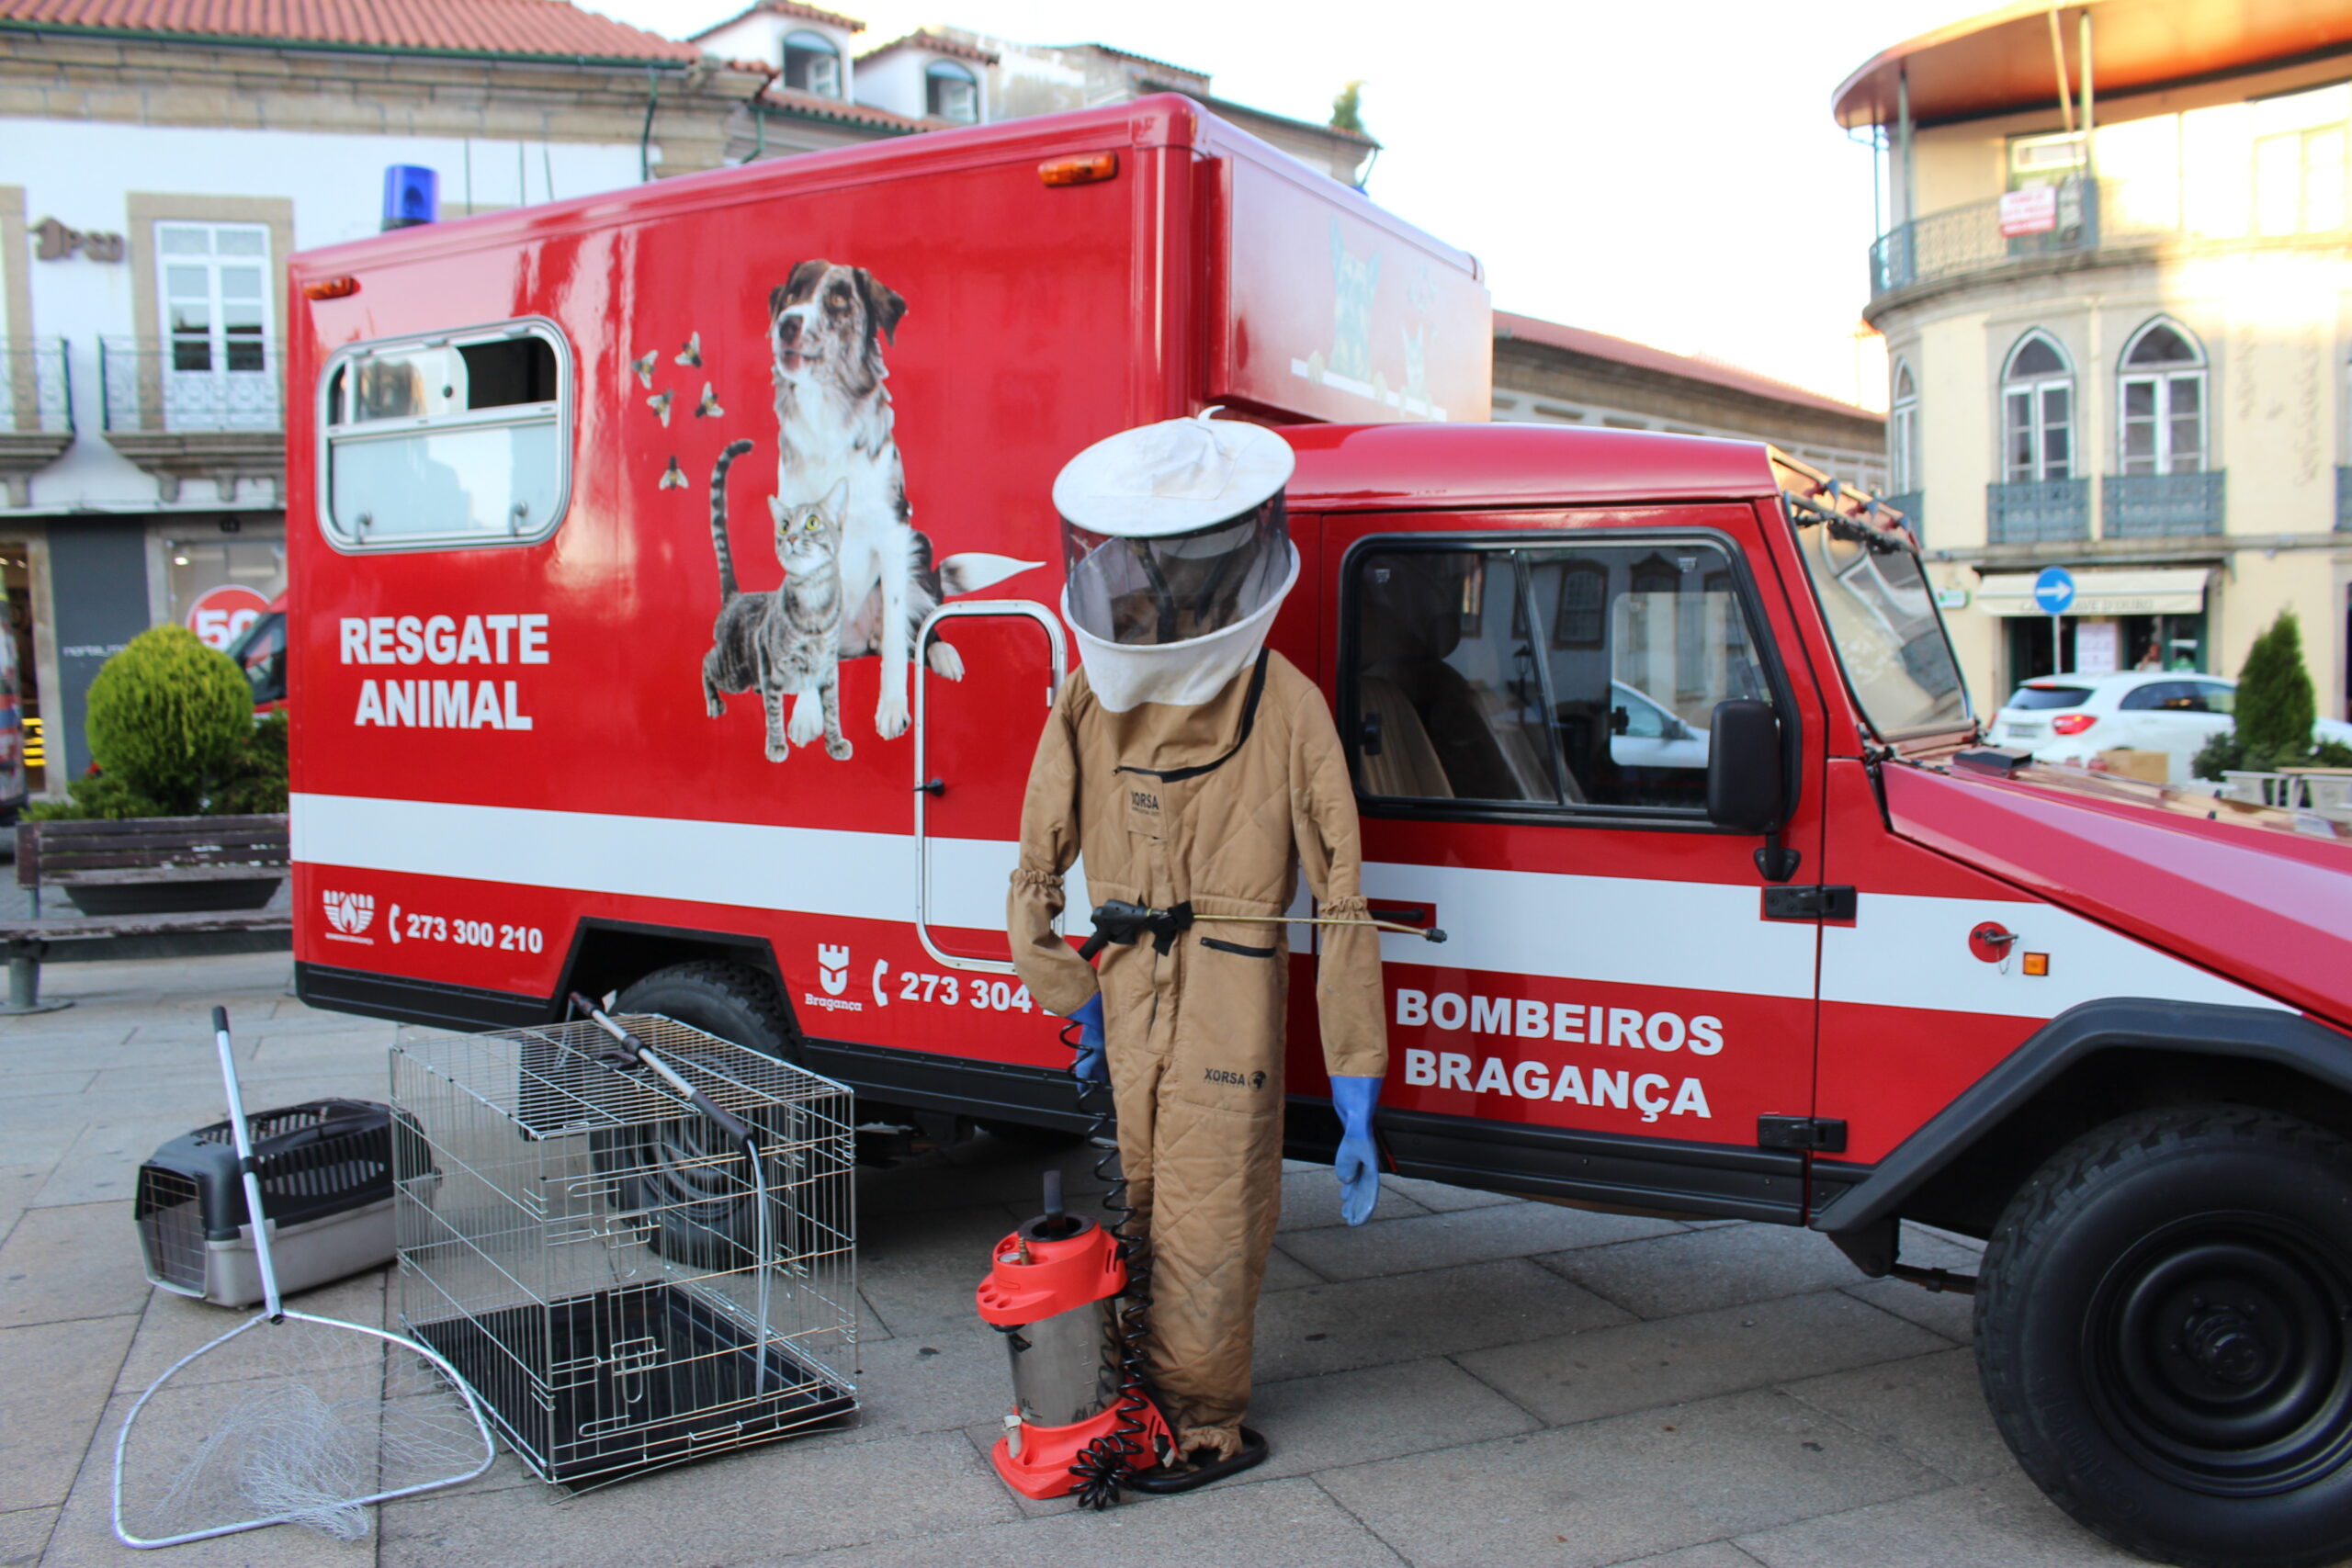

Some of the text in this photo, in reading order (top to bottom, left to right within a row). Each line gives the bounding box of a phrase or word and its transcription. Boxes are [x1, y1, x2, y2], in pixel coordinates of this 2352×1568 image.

[340, 614, 549, 665] RESGATE
[354, 679, 533, 730] ANIMAL
[406, 912, 447, 942] 273
[452, 919, 494, 948] 300
[499, 924, 544, 954] 210
[804, 993, 863, 1011] Bragança
[899, 971, 1033, 1014] 273 304
[1396, 987, 1724, 1056] BOMBEIROS
[1204, 1067, 1246, 1087] XORSA
[1405, 1047, 1712, 1123] BRAGANÇA
